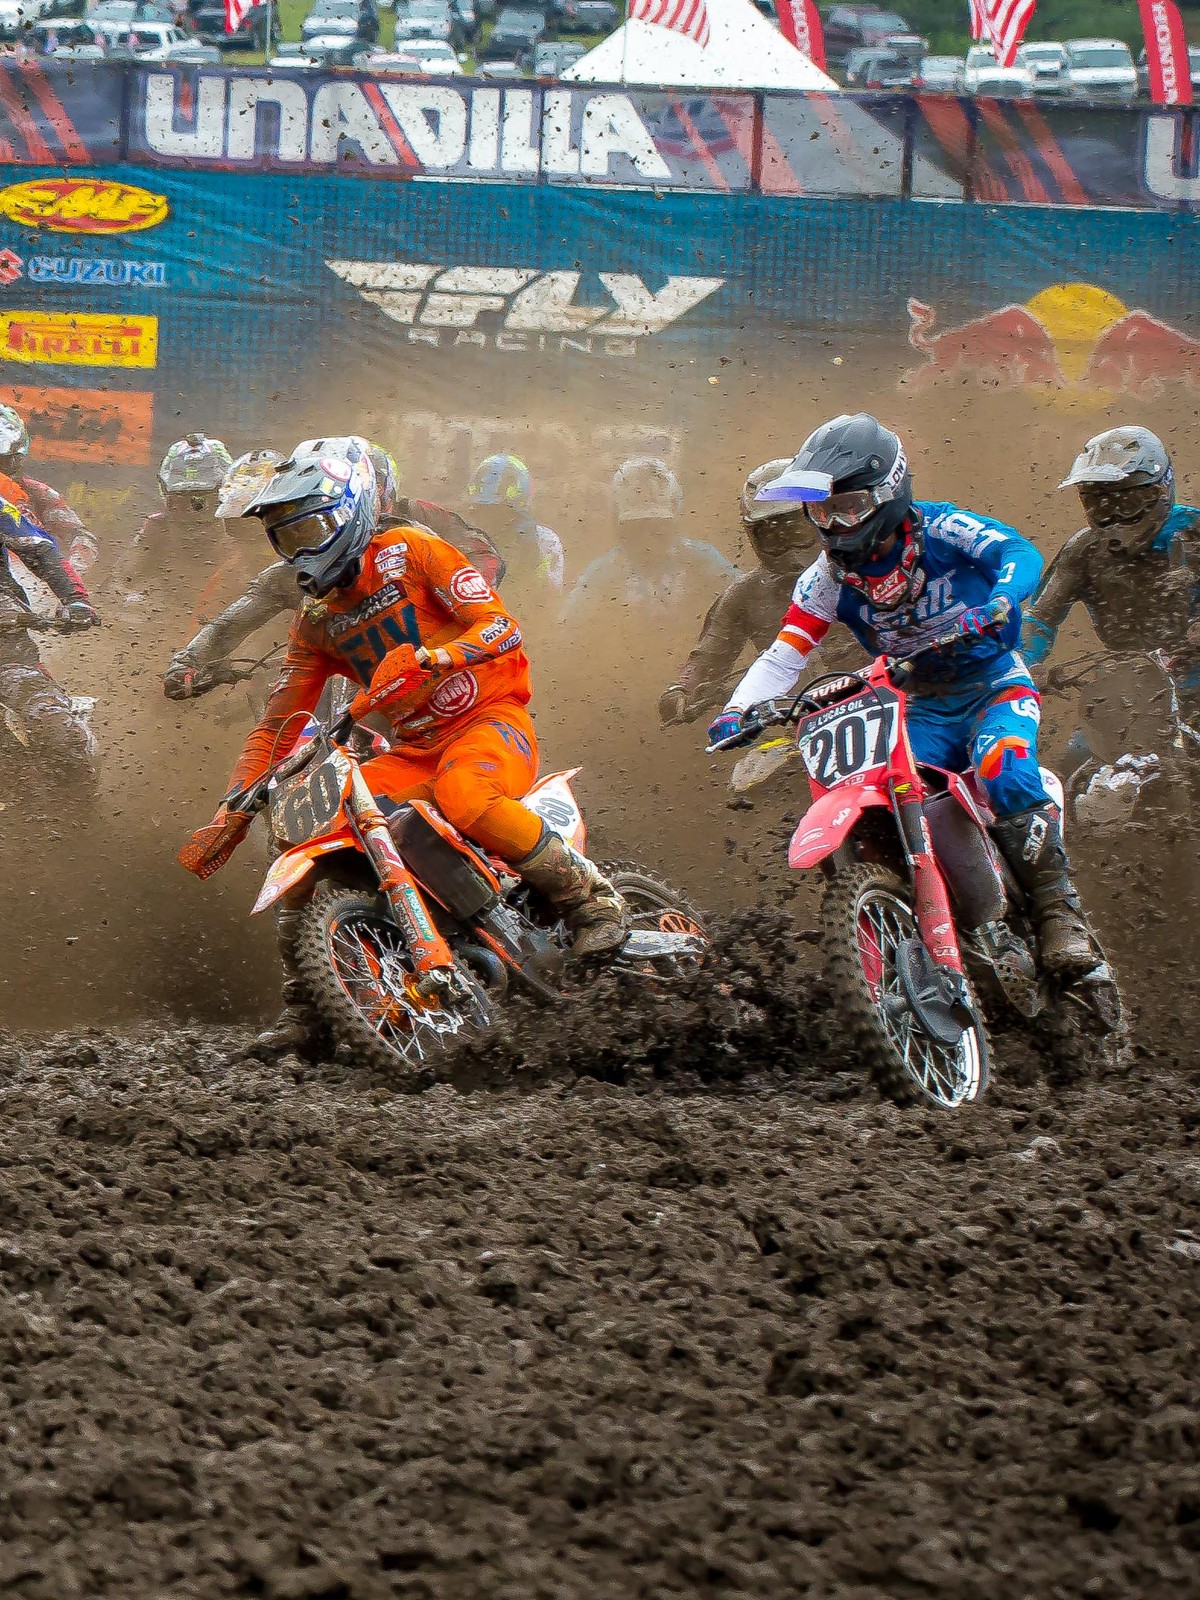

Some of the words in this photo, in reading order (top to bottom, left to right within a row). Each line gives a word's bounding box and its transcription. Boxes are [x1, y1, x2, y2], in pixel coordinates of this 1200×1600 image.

[145, 71, 672, 178] UNADILLA
[28, 255, 165, 287] SUZUKI
[324, 260, 726, 336] FLY
[8, 321, 142, 357] PIRELLI
[407, 327, 637, 358] RACING
[817, 704, 847, 726] LUCAS
[847, 699, 865, 712] OIL
[810, 705, 894, 786] 207
[284, 762, 341, 845] 60
[535, 797, 574, 826] 60
